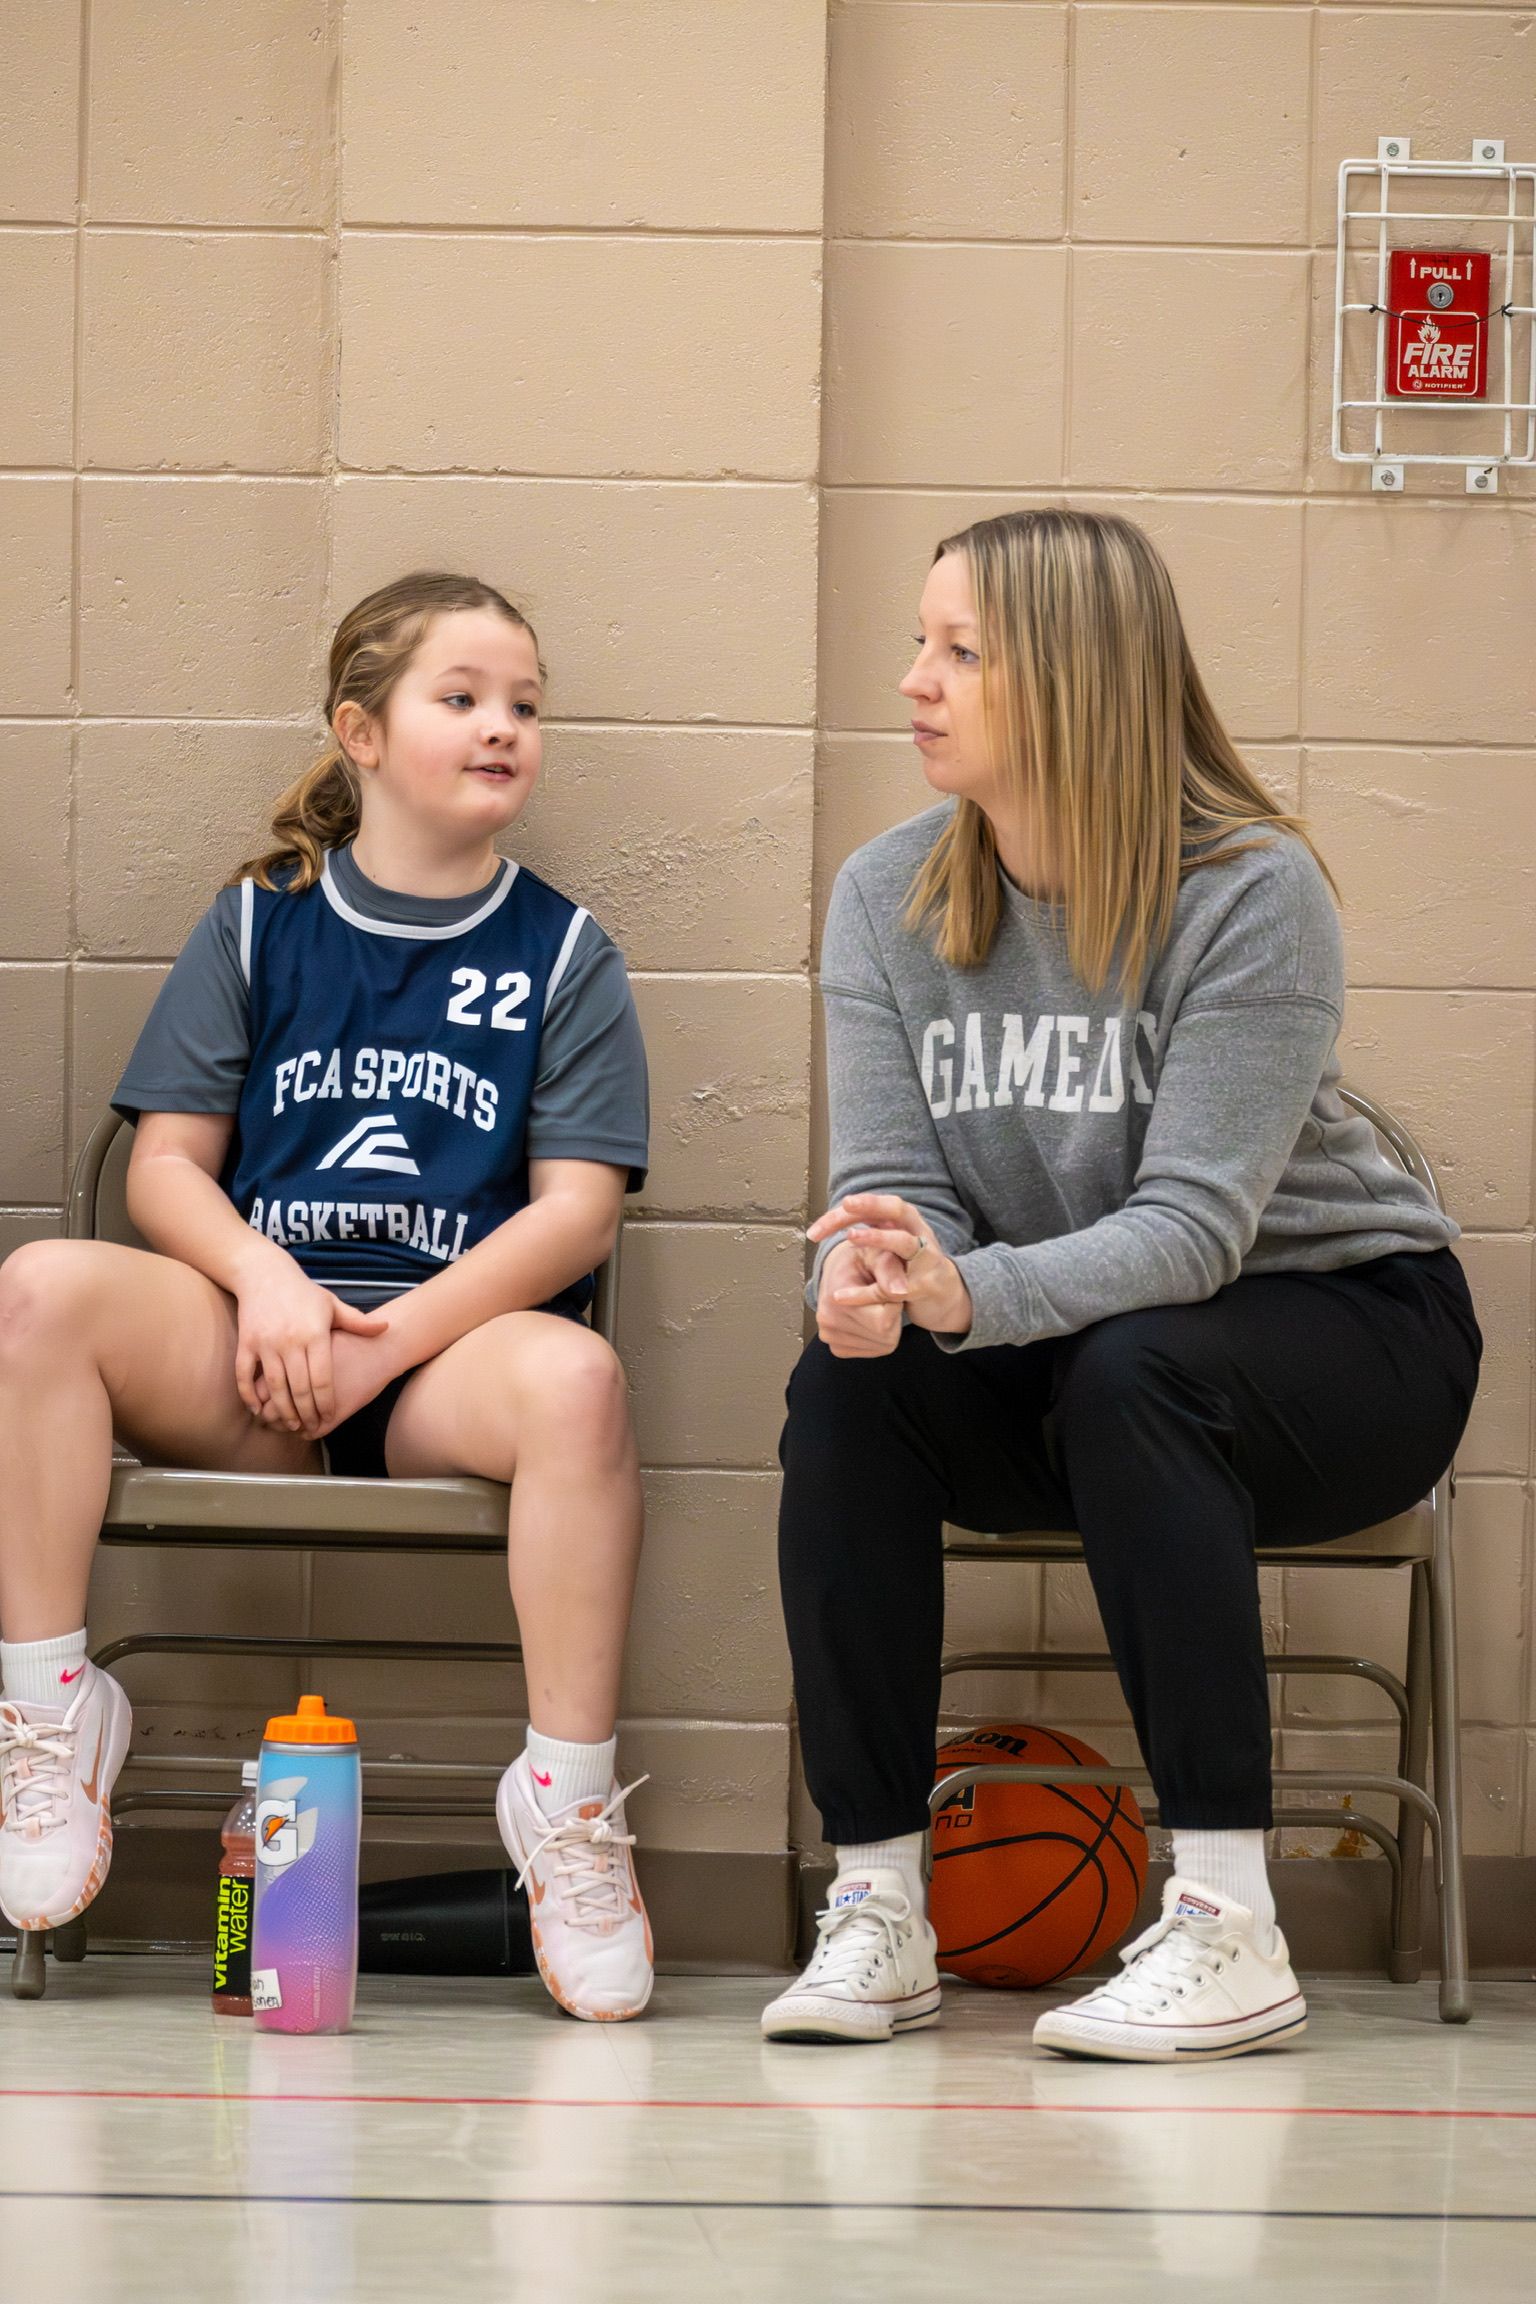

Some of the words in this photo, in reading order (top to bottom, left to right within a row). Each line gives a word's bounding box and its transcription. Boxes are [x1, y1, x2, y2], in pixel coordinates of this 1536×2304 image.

[1420, 266, 1462, 280] PULL
[1403, 342, 1474, 366] FIRE
[1407, 364, 1468, 379] ALARM
[446, 966, 532, 1031] 22
[273, 1047, 343, 1117] FCA
[351, 1047, 499, 1132] SPORTS
[249, 1197, 470, 1263] BASKETBALL
[214, 1876, 232, 1990] vitamin
[229, 1878, 249, 1954] water
